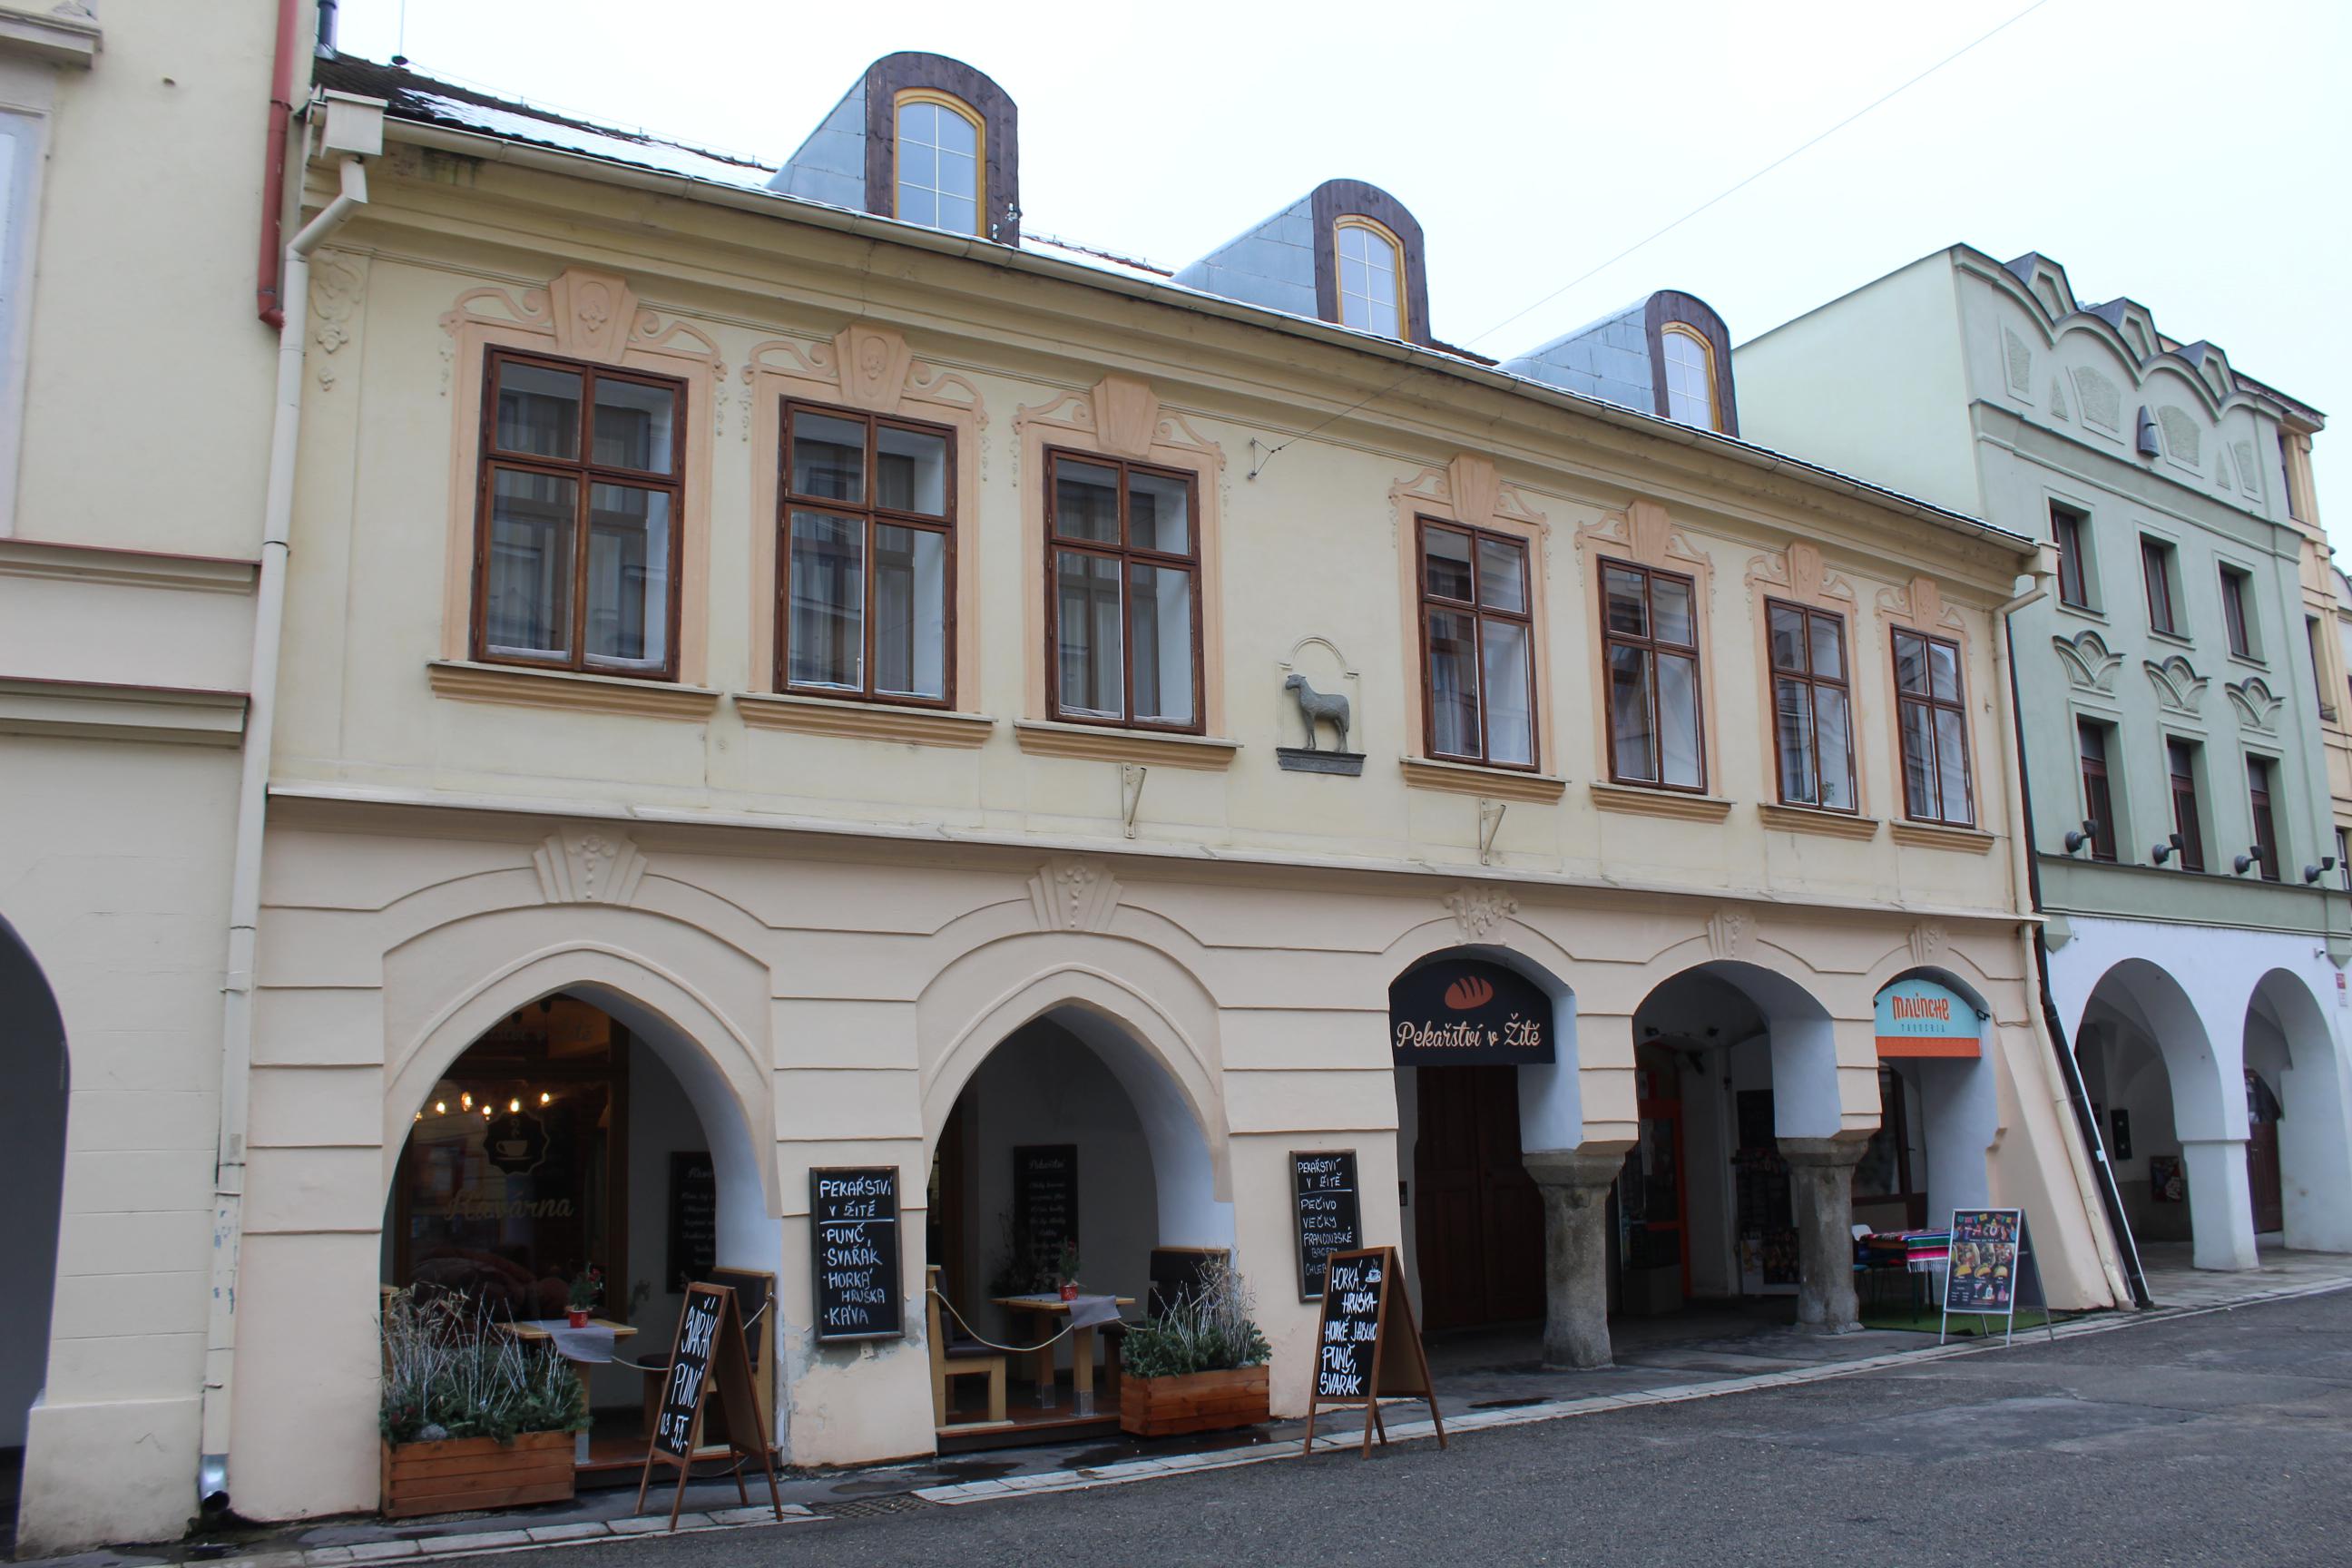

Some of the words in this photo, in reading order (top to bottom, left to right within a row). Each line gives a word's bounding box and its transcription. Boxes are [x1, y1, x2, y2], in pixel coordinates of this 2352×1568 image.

[1396, 1020, 1485, 1047] Pekařství
[1487, 1031, 1498, 1047] v
[1504, 1013, 1542, 1047] Žitě
[1297, 1157, 1342, 1173] PEKAŘSTVÍ
[819, 1176, 893, 1198] PEKAŘSTVÍ
[843, 1200, 876, 1217] ŽITĚ
[1300, 1197, 1337, 1210] PEČIVO
[1303, 1215, 1337, 1229] VEČKY
[828, 1240, 883, 1267] SVAŘÁK
[828, 1268, 873, 1289] HORKÁ
[1331, 1259, 1363, 1292] HORKÁ
[842, 1286, 885, 1304] HRUŠKA
[1342, 1284, 1377, 1314] HRUŠKA
[829, 1304, 868, 1326] KÁVA
[1325, 1316, 1350, 1343] HORKÉ
[1319, 1362, 1362, 1396] SVAŘÁK
